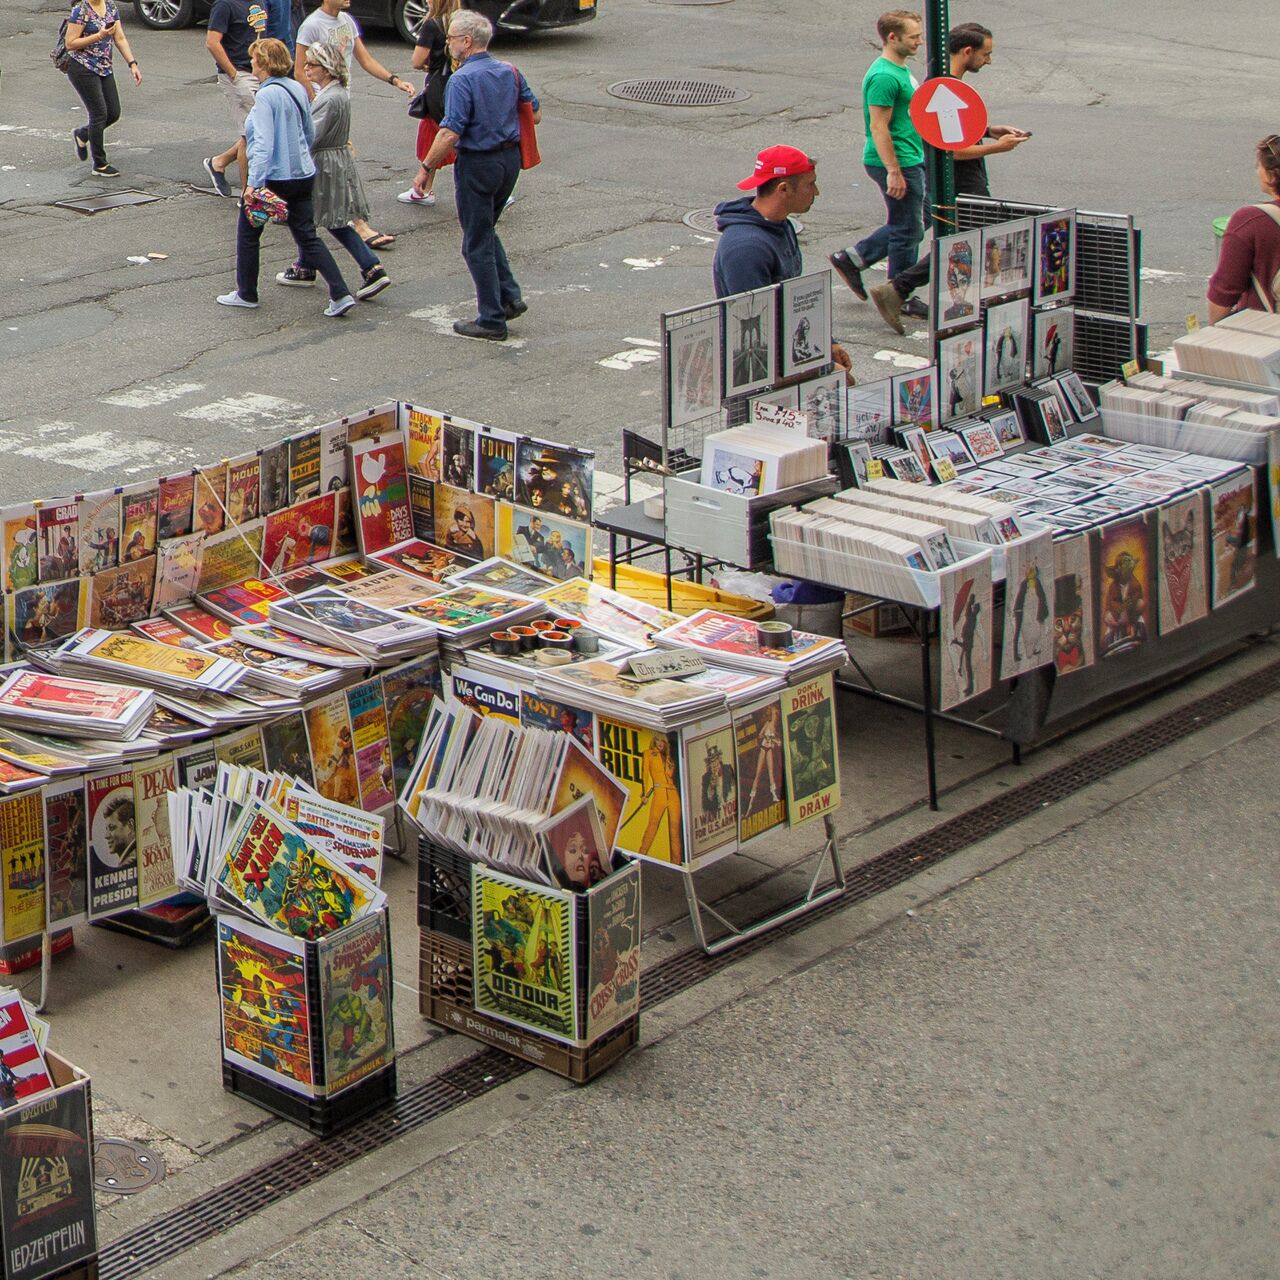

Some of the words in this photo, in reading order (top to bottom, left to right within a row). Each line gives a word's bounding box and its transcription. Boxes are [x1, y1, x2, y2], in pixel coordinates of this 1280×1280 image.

[409, 410, 432, 424] ATTACK
[409, 430, 432, 443] WOMAN
[390, 506, 409, 520] DAYS
[392, 517, 411, 532] PEACE
[393, 529, 412, 542] MUSIC
[636, 662, 655, 676] The
[456, 680, 473, 697] We
[475, 686, 495, 704] Can
[496, 693, 513, 710] Do
[797, 682, 818, 695] DON'T
[791, 688, 825, 710] DRINK
[599, 721, 643, 756] KILL
[600, 748, 643, 784] BILL
[96, 778, 109, 789] TIME
[109, 775, 120, 787] FOR
[698, 809, 721, 827] WANT
[721, 799, 737, 815] YOU
[799, 793, 831, 819] DRAW
[306, 812, 330, 828] BATTLE
[342, 824, 370, 840] CENTURY
[695, 827, 706, 840] FOR
[492, 973, 559, 1011] DETOUR
[466, 1017, 522, 1048] parmalat
